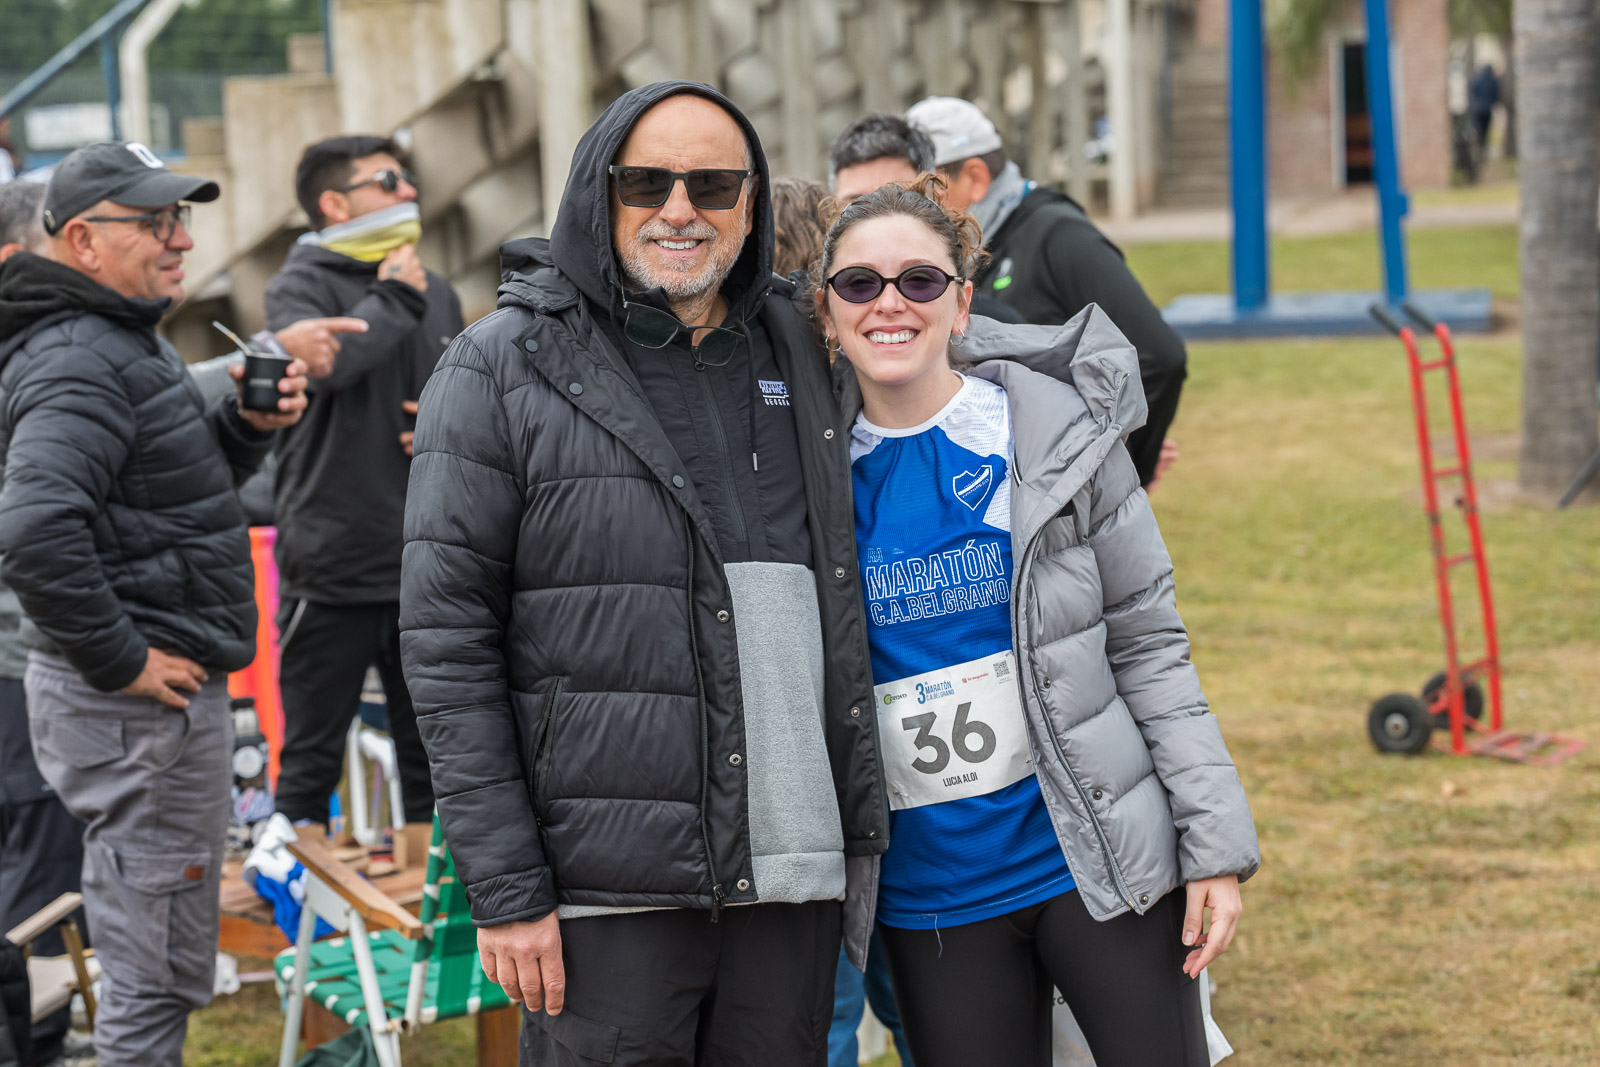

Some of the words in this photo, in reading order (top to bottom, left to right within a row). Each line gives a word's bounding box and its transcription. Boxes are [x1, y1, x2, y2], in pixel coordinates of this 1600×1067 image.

[866, 539, 1005, 600] MARATÓN
[870, 578, 1010, 627] C.A.BELGRANO
[915, 682, 926, 705] 3
[925, 680, 953, 695] MARATÓN
[901, 701, 997, 774] 36
[942, 775, 963, 787] LUCIA
[962, 771, 979, 783] ALOI
